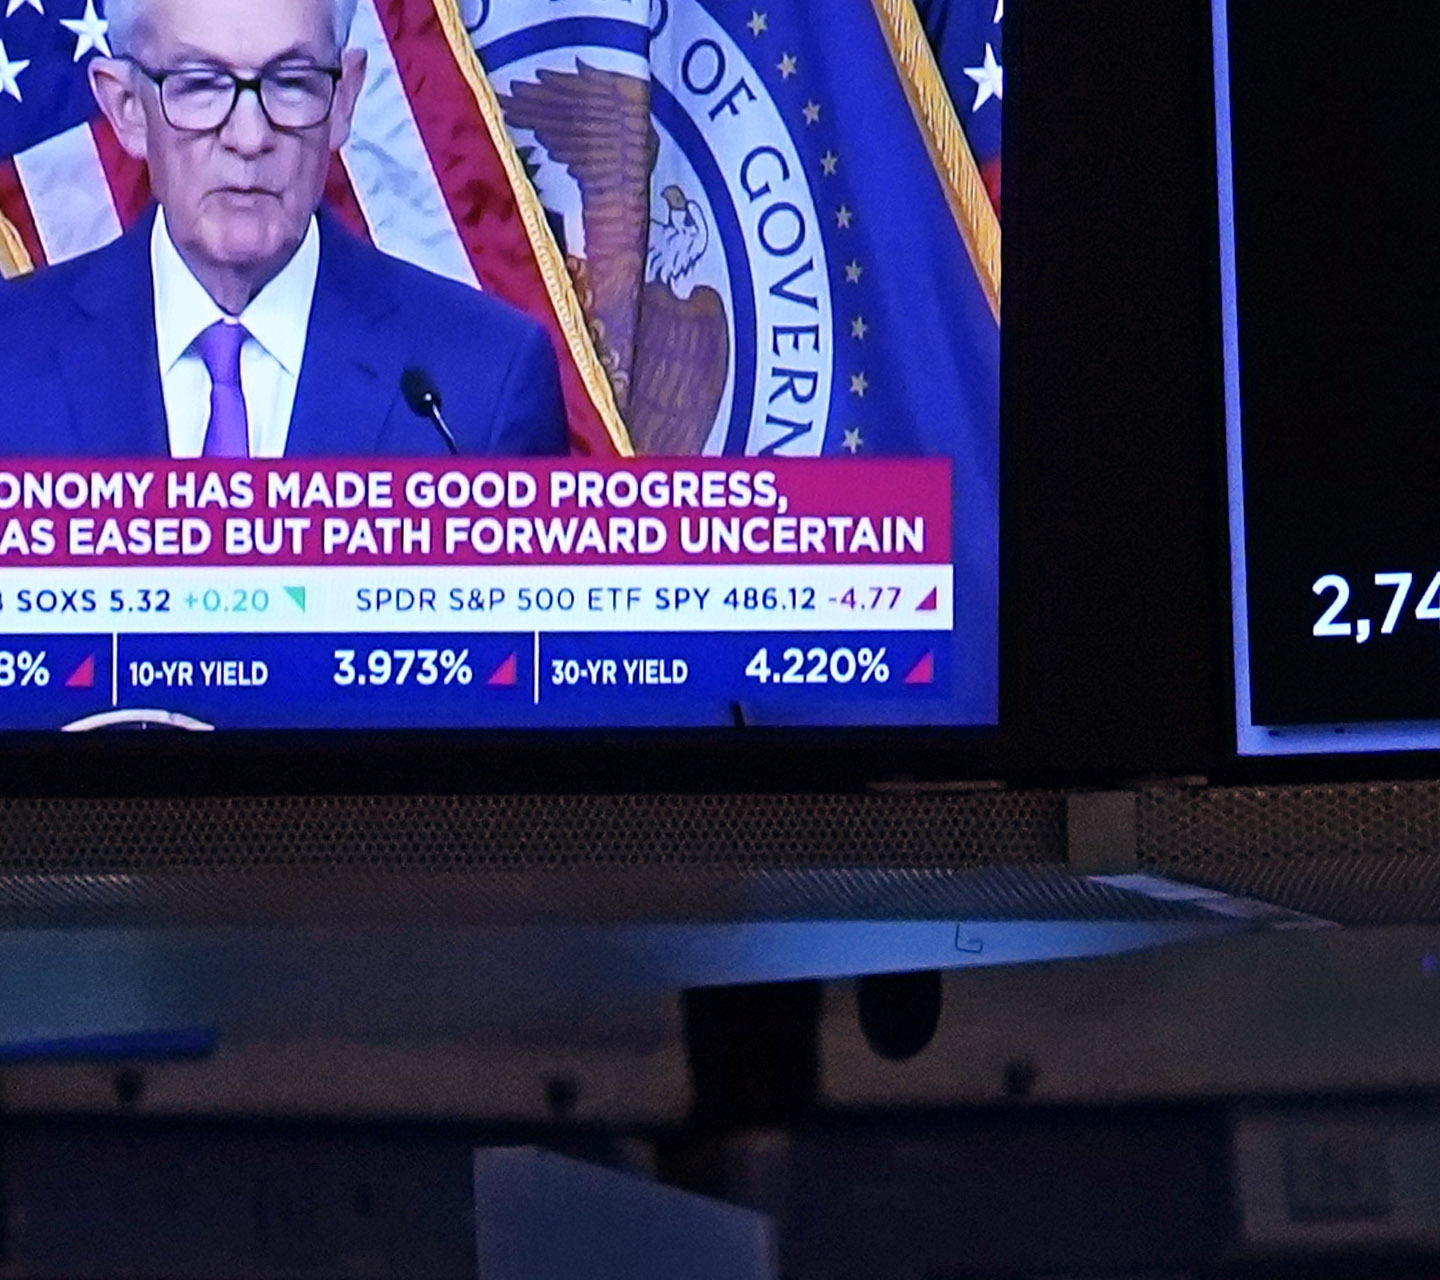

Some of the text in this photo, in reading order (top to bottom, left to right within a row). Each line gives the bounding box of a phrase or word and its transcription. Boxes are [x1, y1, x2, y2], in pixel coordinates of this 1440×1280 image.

[167, 471, 255, 509] HAS
[268, 471, 393, 509] MADE
[405, 471, 538, 509] GOOD
[549, 471, 789, 514] PROGRESS,
[16, 588, 171, 613] SOXS 5.32
[655, 586, 816, 611] SPY 486.12
[332, 649, 473, 687] 3.973%
[744, 647, 890, 685] 4.220%
